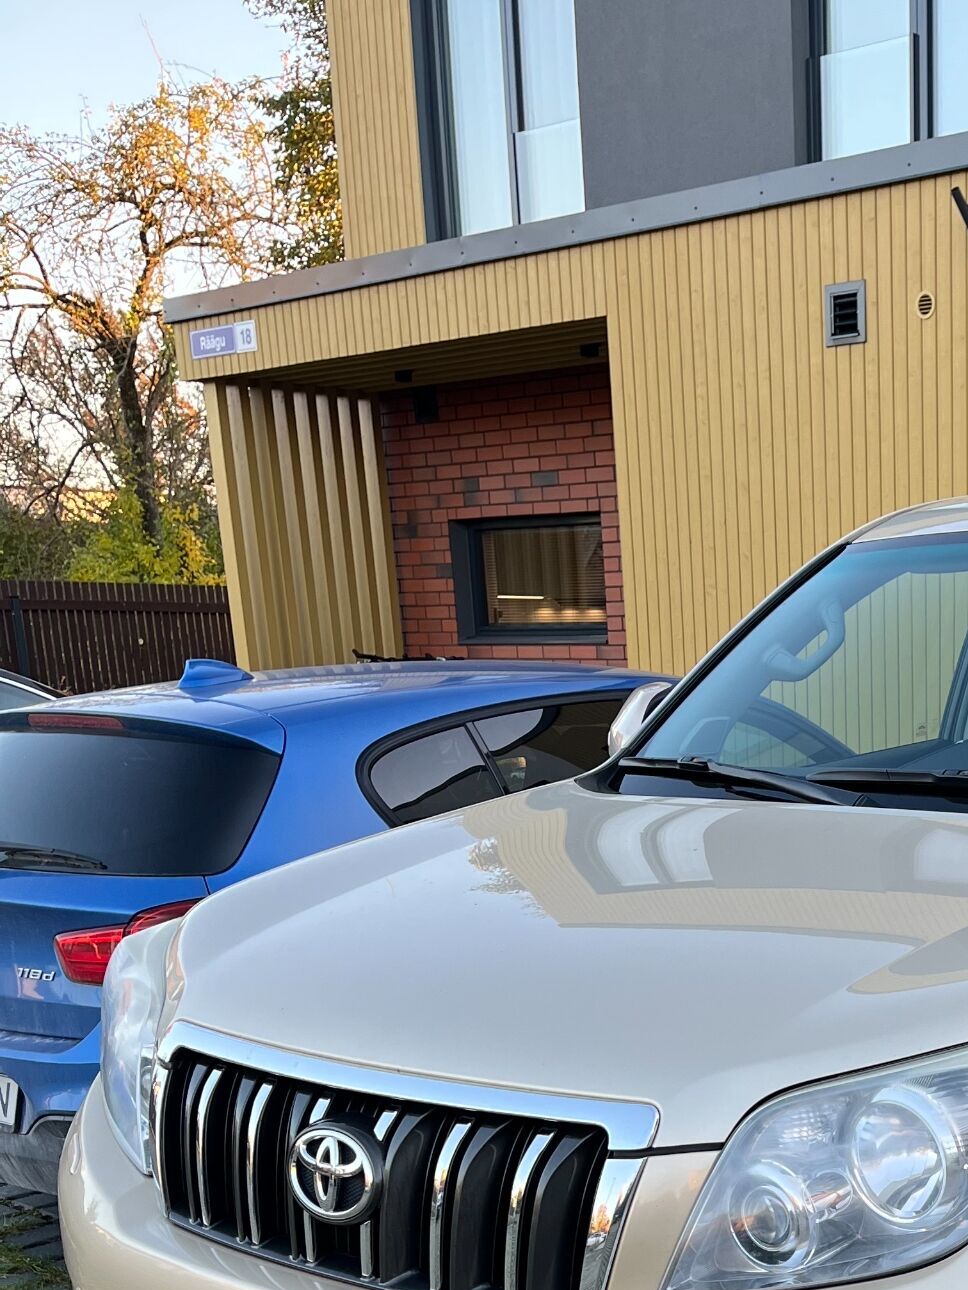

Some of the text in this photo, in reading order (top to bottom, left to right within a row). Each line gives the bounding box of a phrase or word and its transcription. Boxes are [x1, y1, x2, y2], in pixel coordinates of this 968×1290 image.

[200, 327, 252, 351] Räägu 18
[17, 967, 56, 982] 118d
